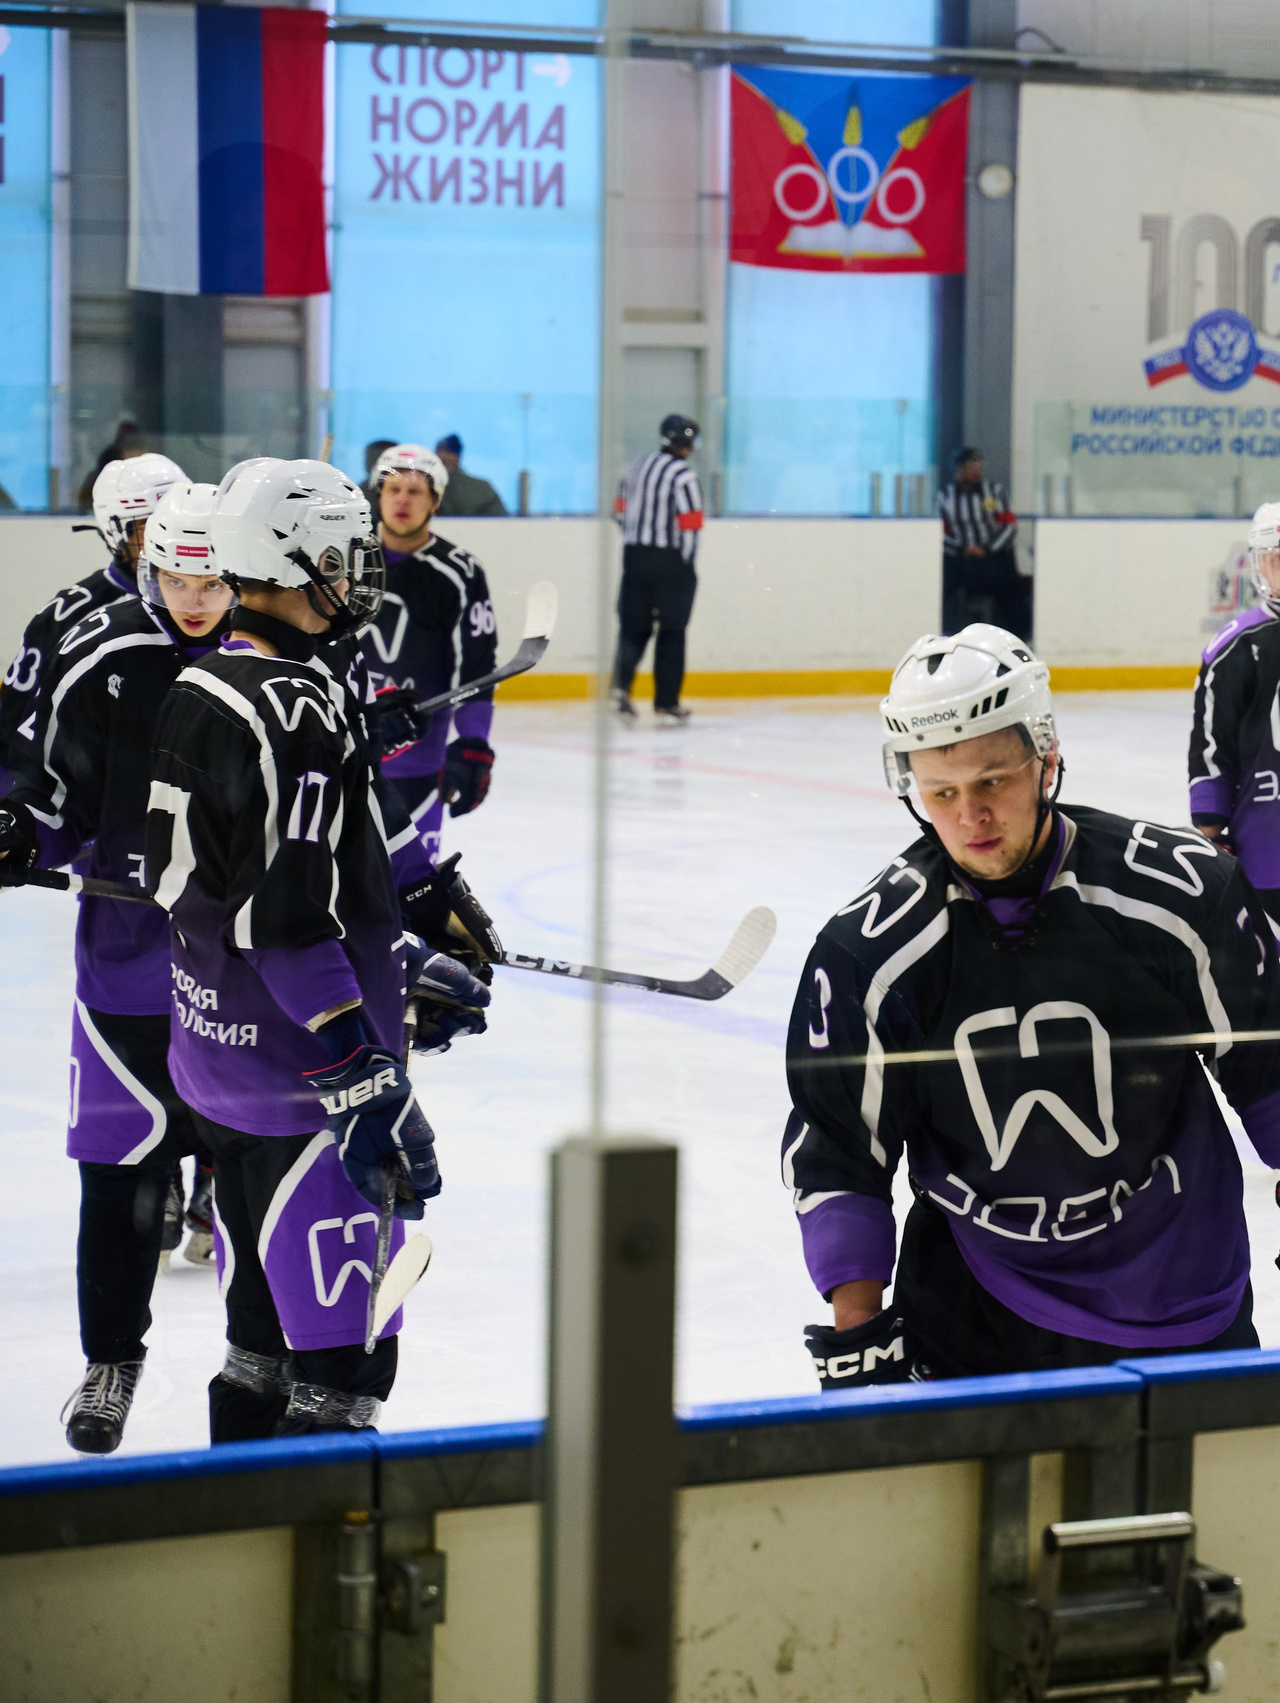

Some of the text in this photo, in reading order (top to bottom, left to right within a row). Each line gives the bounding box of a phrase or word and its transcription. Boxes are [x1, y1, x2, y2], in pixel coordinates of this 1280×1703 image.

[371, 95, 565, 150] НОРМА
[370, 153, 565, 208] ЖИЗНИ
[469, 600, 497, 638] 96
[910, 708, 960, 729] Reebok
[286, 770, 330, 843] 17
[406, 884, 433, 903] CCM
[505, 950, 583, 978] CM
[319, 1067, 400, 1116] UER
